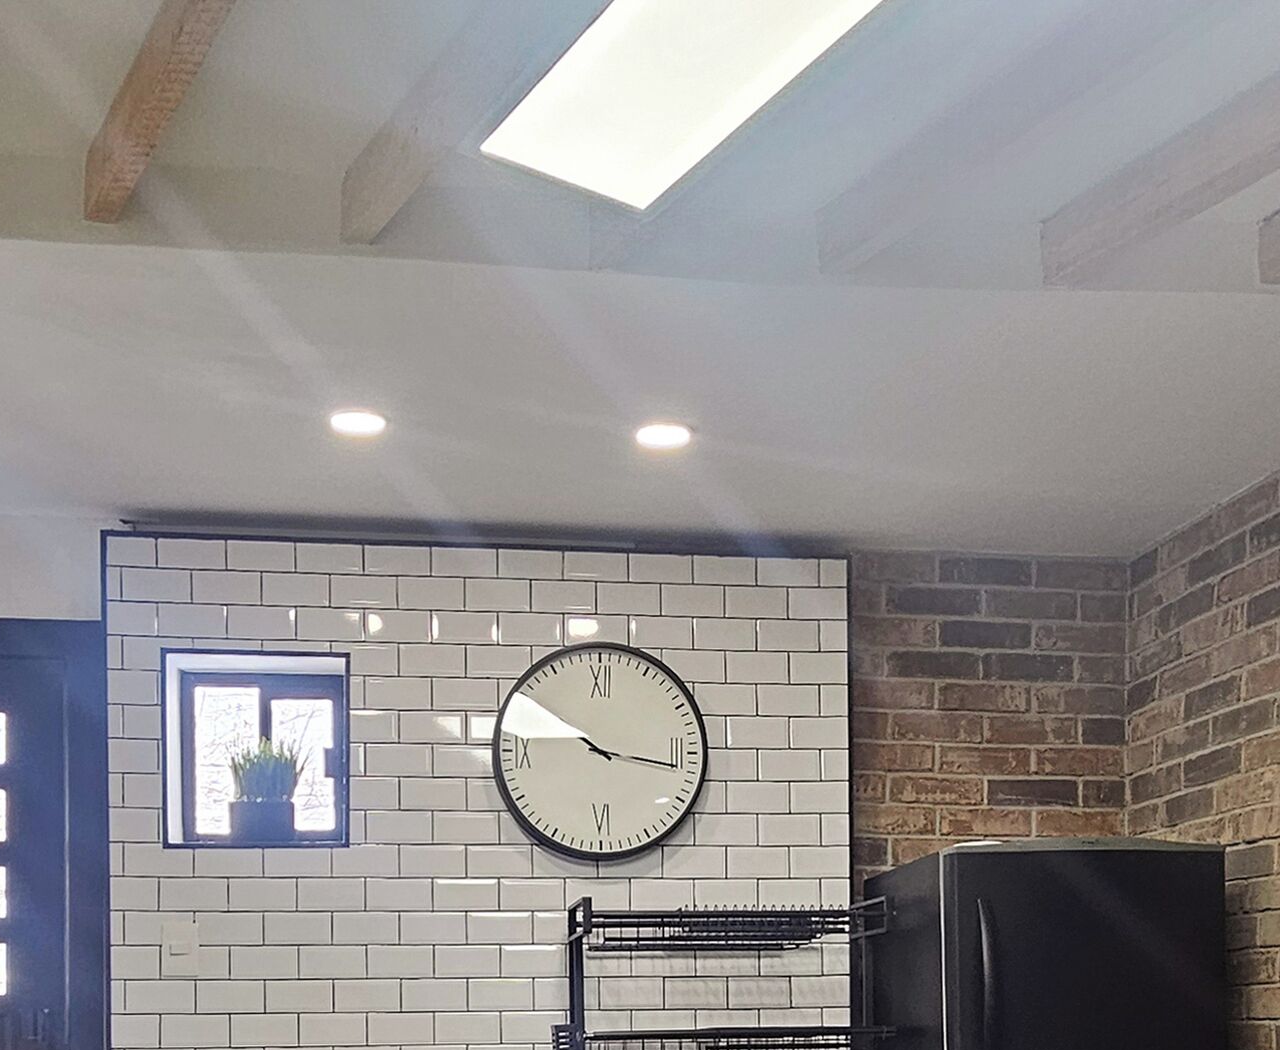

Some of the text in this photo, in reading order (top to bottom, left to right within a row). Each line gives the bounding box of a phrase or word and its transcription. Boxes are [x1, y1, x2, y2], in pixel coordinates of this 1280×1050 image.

[589, 664, 611, 698] XII
[514, 735, 531, 769] IX
[670, 737, 683, 769] III
[591, 803, 610, 837] VI
